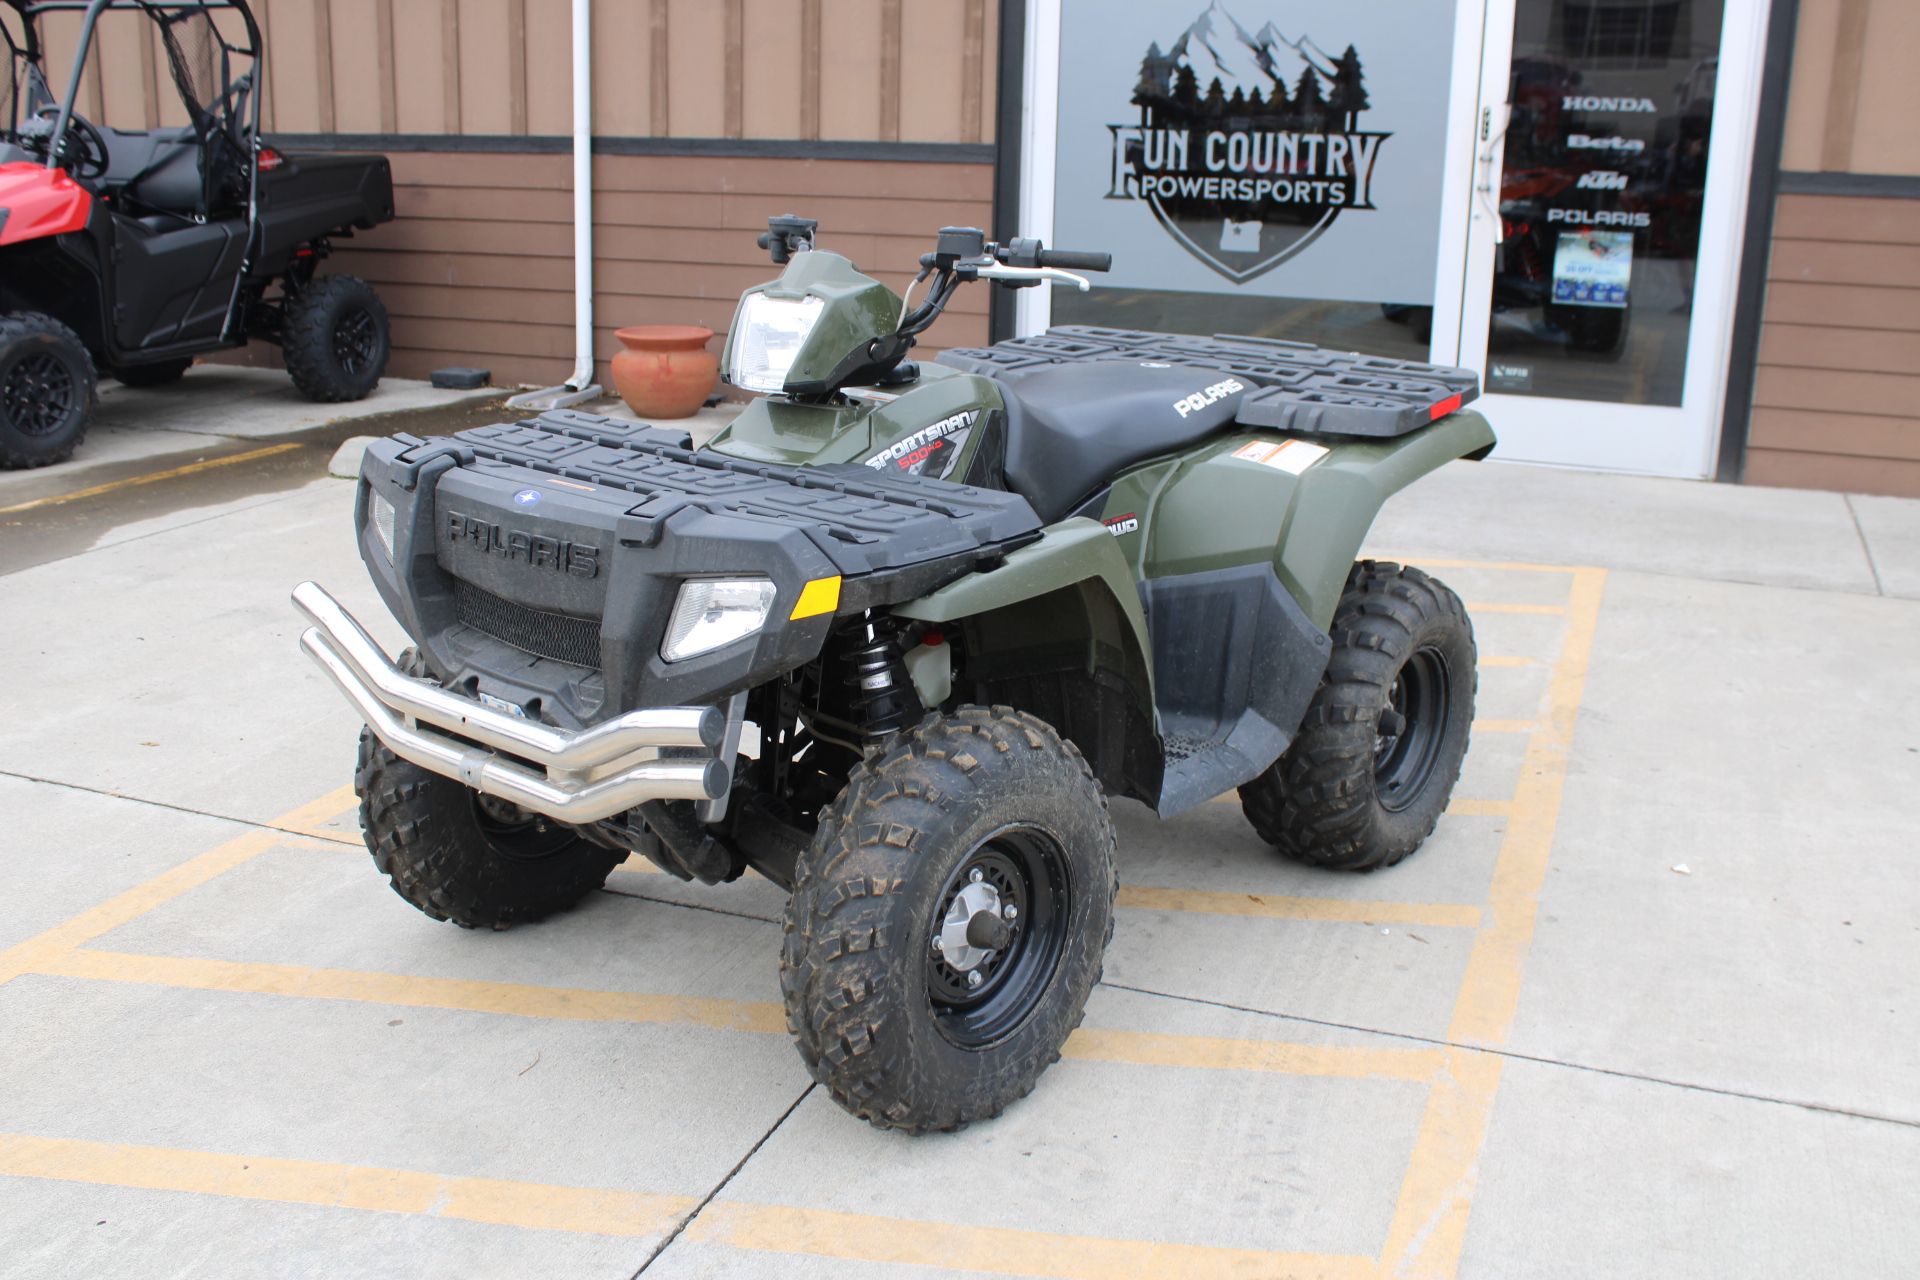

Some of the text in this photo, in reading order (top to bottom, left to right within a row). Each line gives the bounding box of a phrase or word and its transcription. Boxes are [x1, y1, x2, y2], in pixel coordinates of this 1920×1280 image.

[1562, 96, 1656, 113] HONDA
[1567, 134, 1646, 154] Beta
[1104, 124, 1394, 209] FUN COUNTRY
[1576, 170, 1629, 190] KTM
[1141, 175, 1346, 204] POWERSPORTS
[1547, 208, 1651, 227] POLARIS
[1172, 378, 1244, 418] POLARIS
[865, 411, 972, 471] SPORTSMAN
[447, 510, 600, 578] POLARIS
